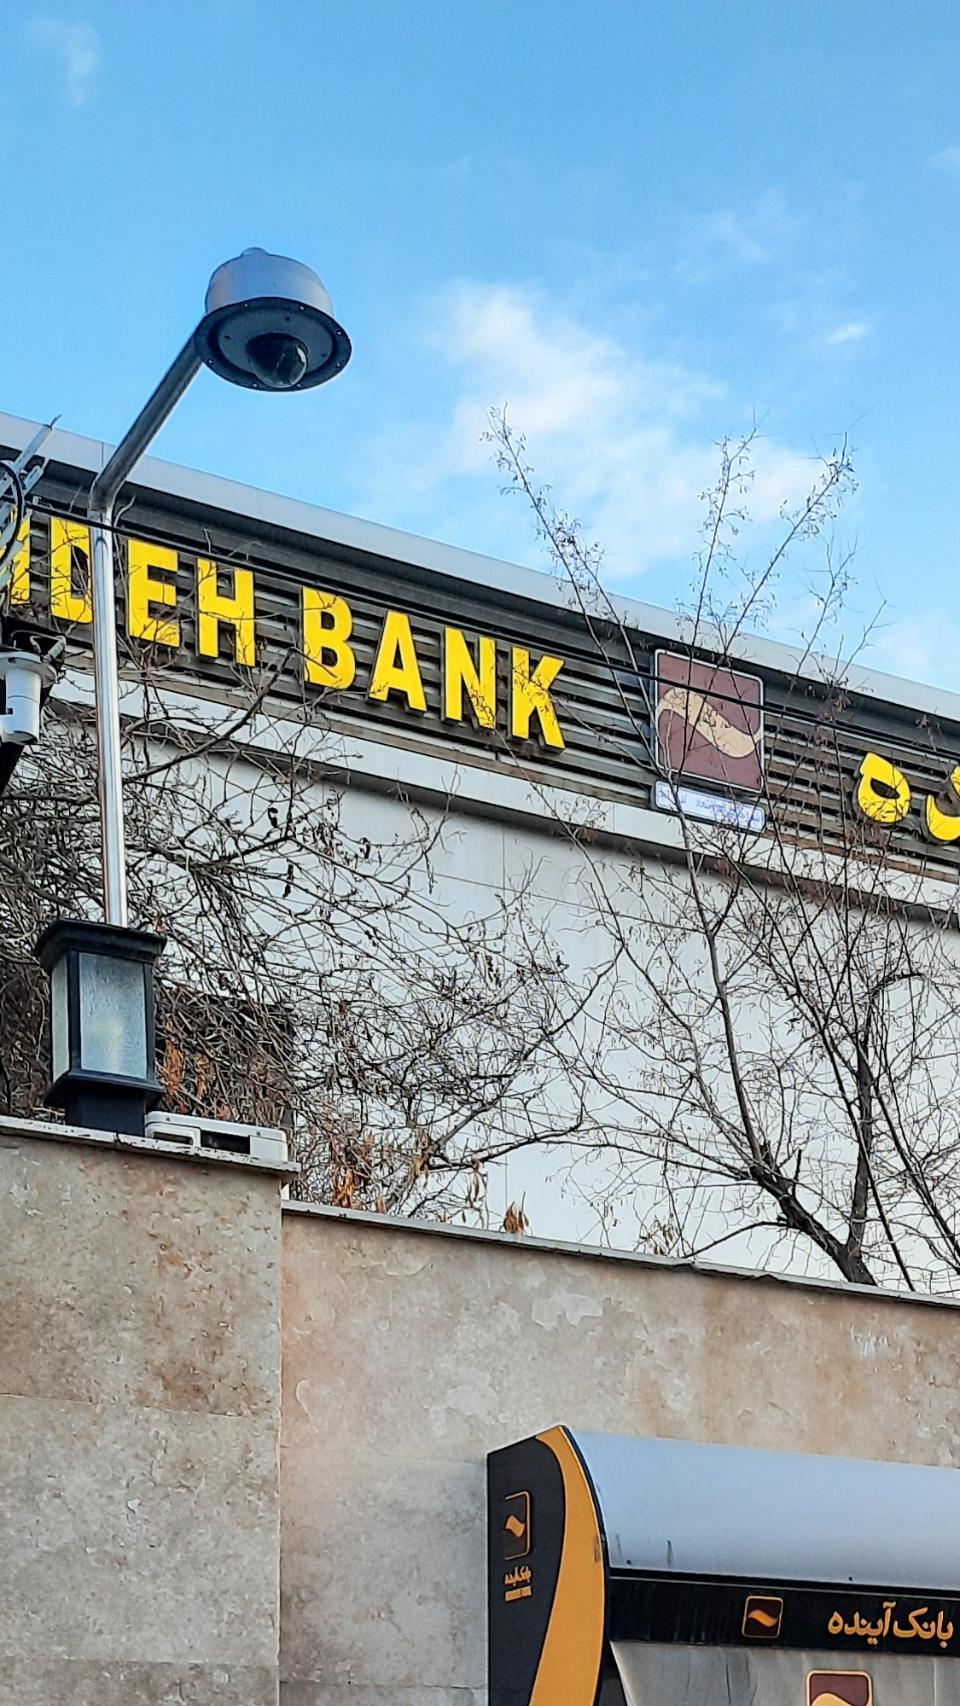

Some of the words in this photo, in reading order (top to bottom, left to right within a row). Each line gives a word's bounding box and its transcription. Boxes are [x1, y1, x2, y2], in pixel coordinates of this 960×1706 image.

[303, 586, 567, 750] BANK
[827, 1601, 897, 1646] آینده
[893, 1606, 954, 1649] بانک
